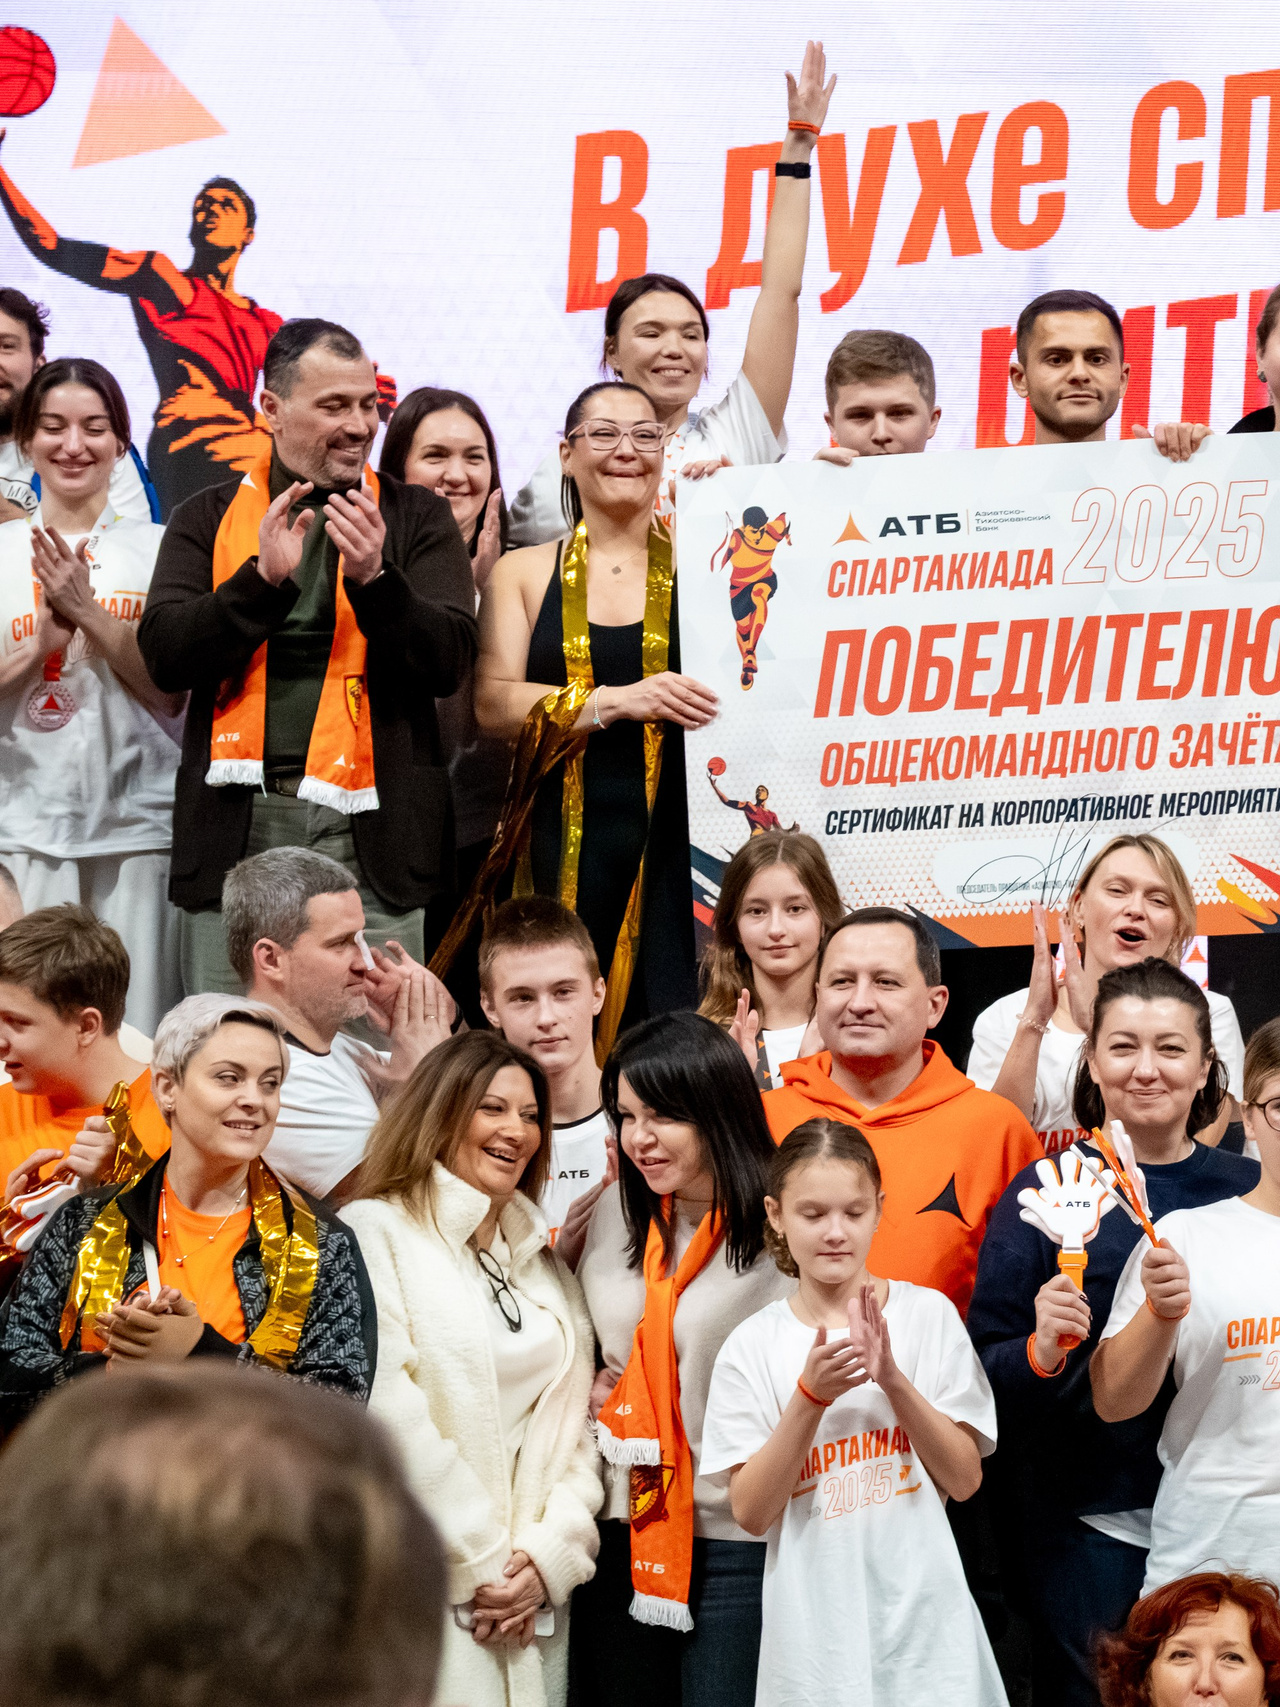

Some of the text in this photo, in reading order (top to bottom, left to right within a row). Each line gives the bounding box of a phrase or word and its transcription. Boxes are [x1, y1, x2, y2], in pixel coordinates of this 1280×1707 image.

[566, 129, 650, 313] В
[705, 100, 1070, 313] духе
[878, 512, 962, 538] АТБ
[974, 513, 1051, 524] Тихоокеанский
[826, 479, 1269, 599] СПАРТАКИАДА 2025
[215, 732, 241, 743] АТБ
[820, 725, 1160, 788] ОБЩЕКОМАНДНОГО
[825, 804, 955, 836] СЕРТИФИКАТ
[957, 802, 985, 829] НА
[990, 794, 1154, 828] КОРПОРАТИВНОЕ
[558, 1169, 590, 1180] АТБ
[823, 1462, 893, 1521] 2025
[633, 1560, 666, 1575] АТБ
